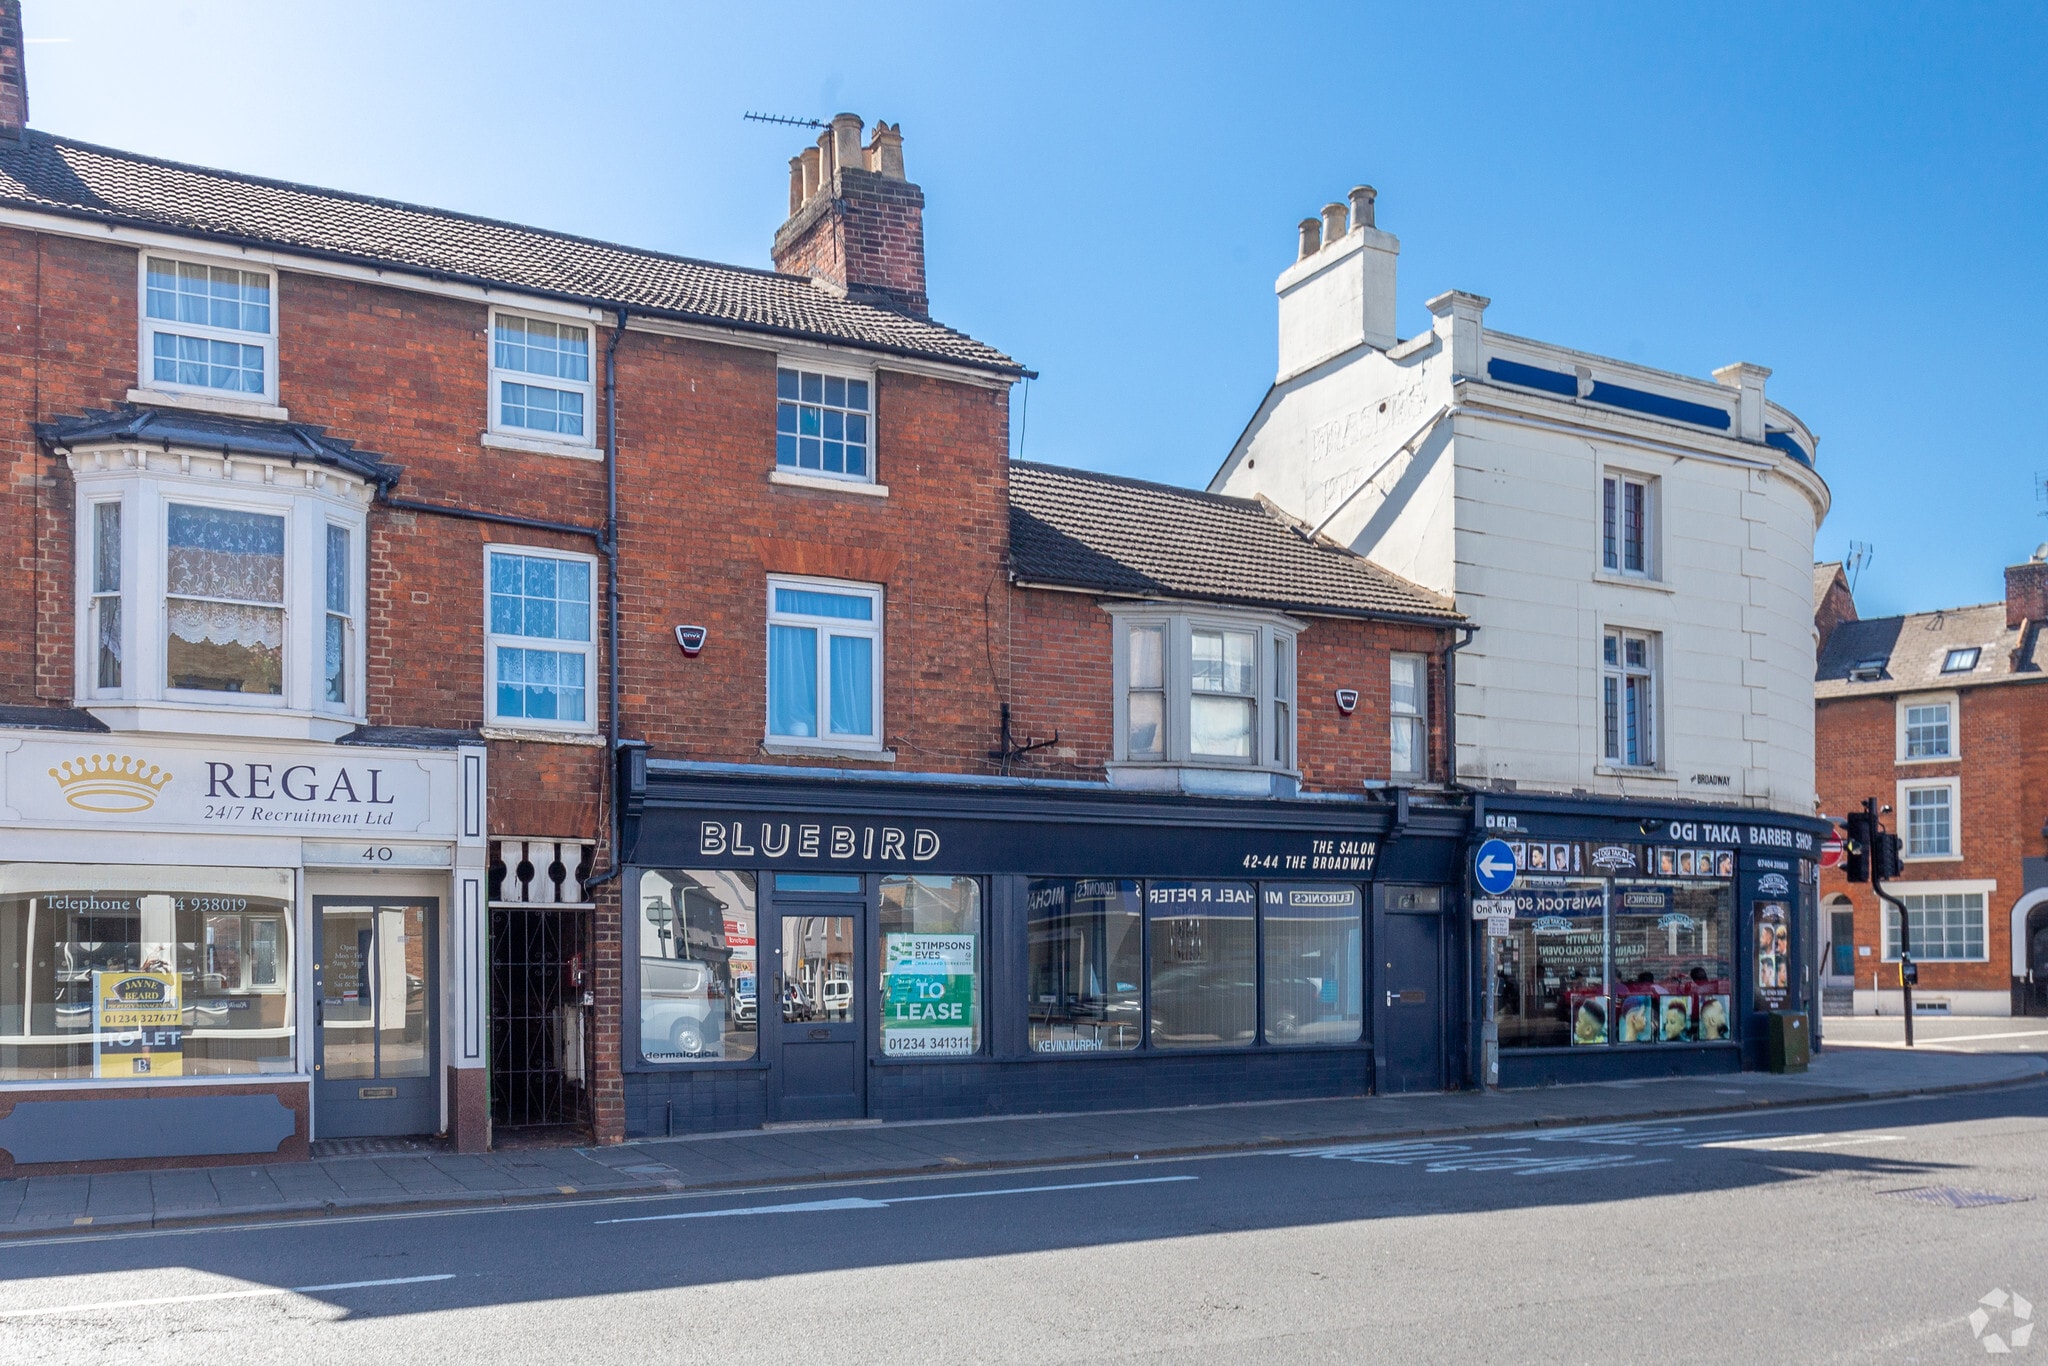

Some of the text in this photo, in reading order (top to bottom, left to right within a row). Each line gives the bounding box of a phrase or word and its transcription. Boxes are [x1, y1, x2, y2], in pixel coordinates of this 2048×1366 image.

[205, 761, 395, 804] REGAL
[1697, 774, 1731, 786] BROADWAY
[204, 805, 394, 826] 24/7 Recruitment Ltd
[700, 821, 941, 861] BLUEBIRD
[1669, 821, 1813, 851] OGI TAKA BARBER SHOP
[362, 846, 393, 861] 40
[1312, 840, 1375, 855] THE SALON
[1243, 854, 1374, 870] 42-44 THE BROADWAY
[43, 895, 130, 914] Telephone
[191, 898, 247, 912] 938019
[1476, 904, 1512, 915] One Way
[915, 941, 971, 950] STIMPSONS
[915, 951, 941, 959] EVES
[125, 980, 157, 990] JAYNE
[916, 982, 944, 998] TO
[125, 992, 159, 1000] BEARD
[896, 1003, 962, 1020] LEASE
[105, 1014, 179, 1023] 01234 327677
[142, 1032, 180, 1046] LET
[889, 1037, 969, 1050] 01234 341311
[1039, 1040, 1102, 1052] KEVIN.MURPHY
[645, 1051, 719, 1060] dermalogica
[137, 1060, 148, 1072] B
